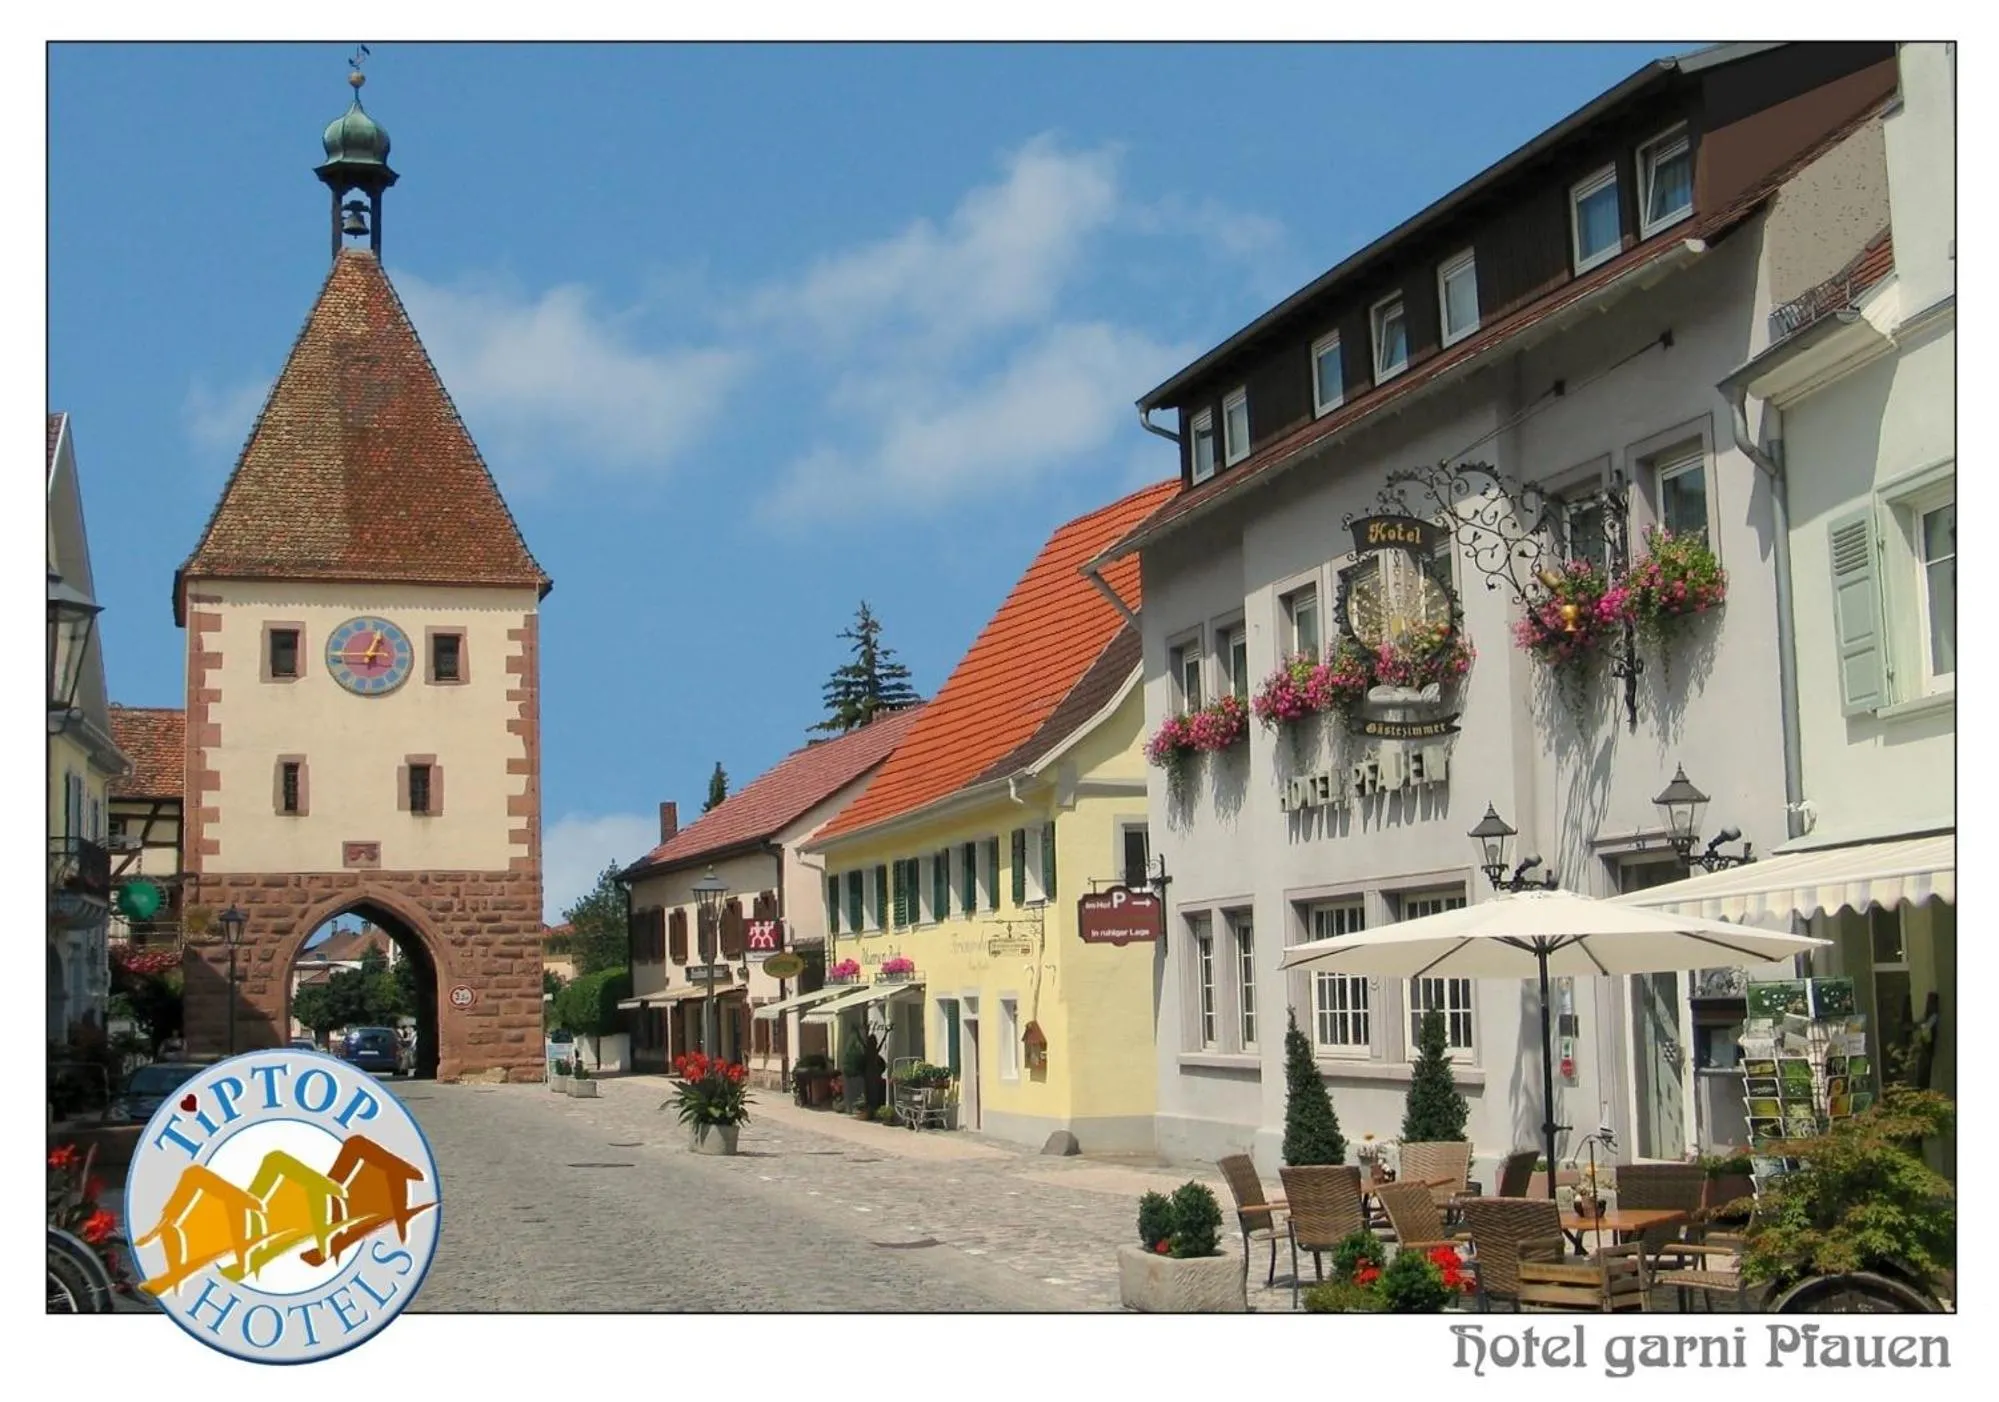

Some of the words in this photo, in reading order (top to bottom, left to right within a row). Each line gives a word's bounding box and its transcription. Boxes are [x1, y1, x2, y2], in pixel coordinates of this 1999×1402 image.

[1368, 522, 1422, 544] Hotel
[1352, 743, 1448, 796] PFAUEN
[1112, 892, 1126, 908] P
